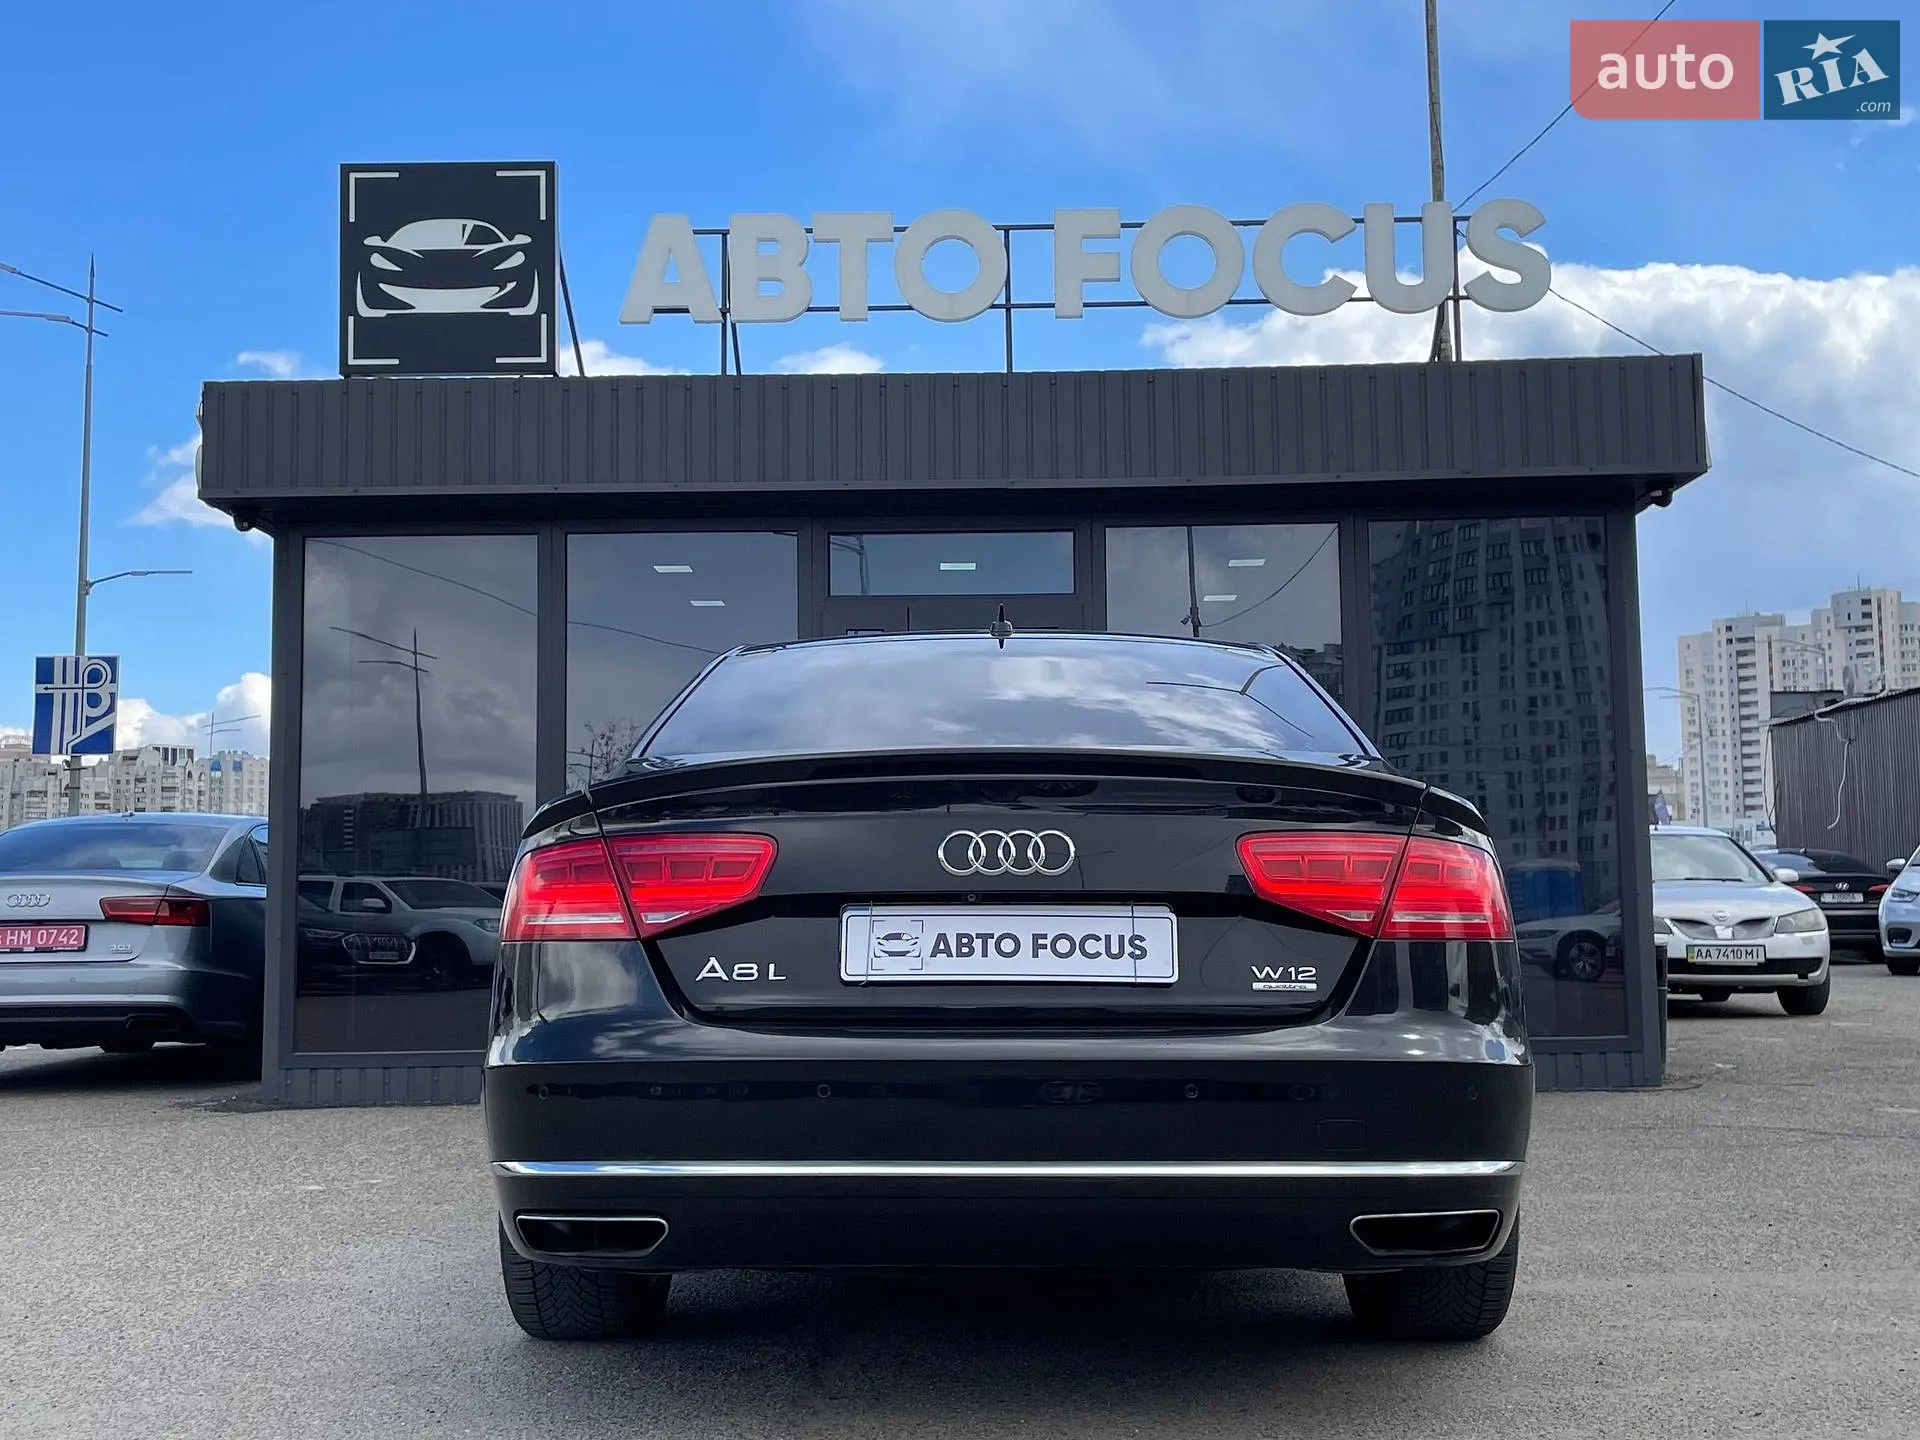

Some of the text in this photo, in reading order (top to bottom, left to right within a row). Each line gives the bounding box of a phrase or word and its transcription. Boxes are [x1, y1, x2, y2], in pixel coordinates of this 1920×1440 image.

[619, 198, 1552, 324] АВТО FOCUS
[6, 929, 79, 946] HM 0742
[929, 932, 1148, 960] АВТО FOCUS
[1696, 948, 1712, 960] AA
[1715, 948, 1743, 960] 7410
